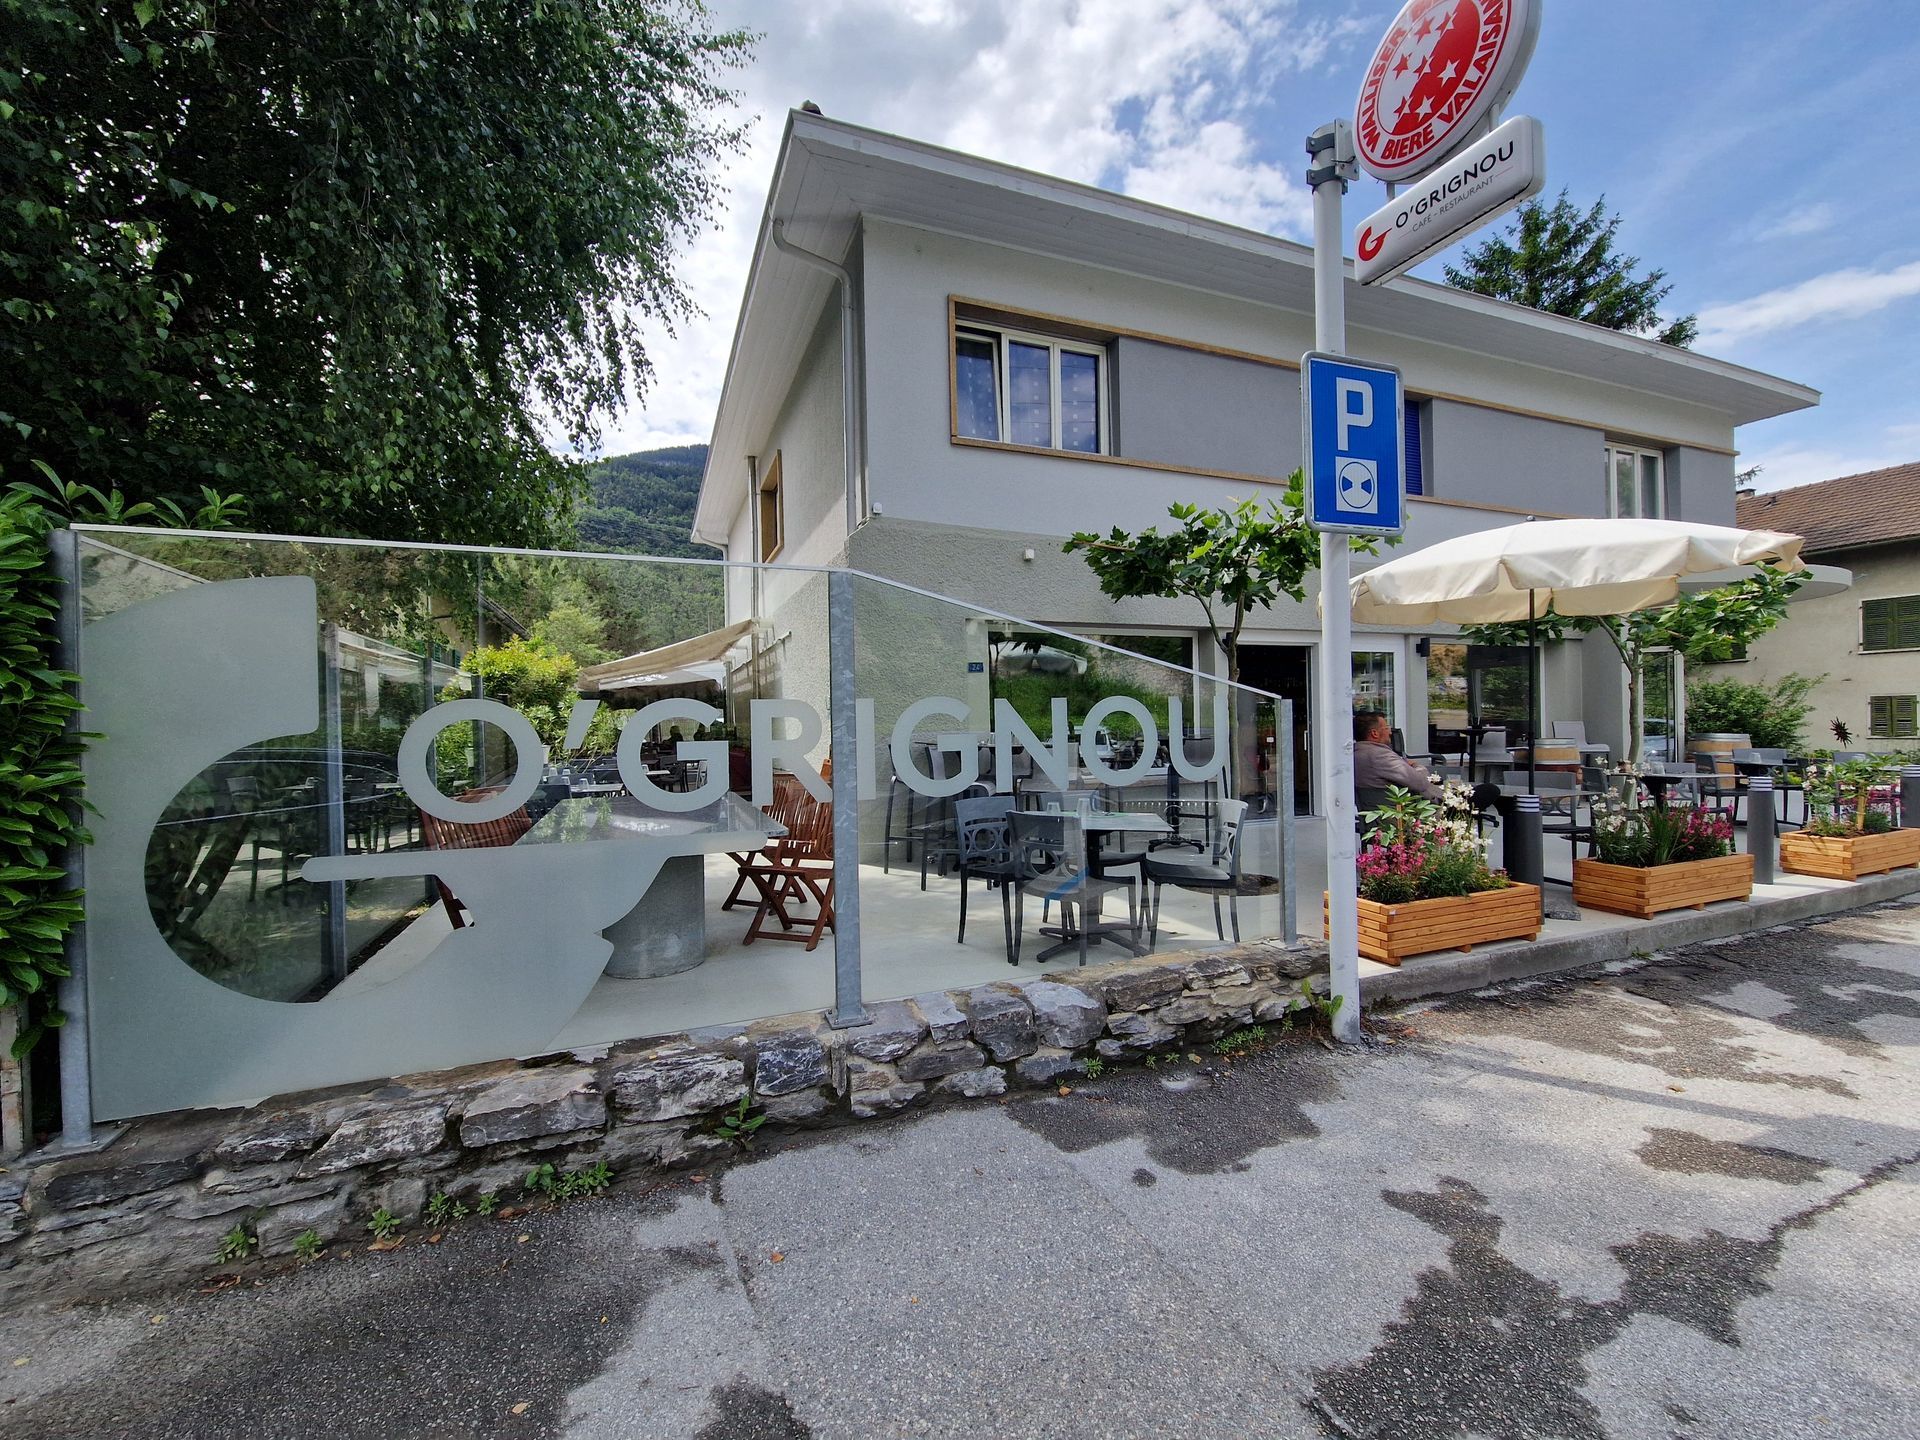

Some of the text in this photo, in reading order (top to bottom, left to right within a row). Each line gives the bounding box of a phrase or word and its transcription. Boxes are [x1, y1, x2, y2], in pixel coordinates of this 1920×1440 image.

[1361, 27, 1407, 153] WALLISER
[1381, 122, 1435, 160] BIERE
[1395, 141, 1514, 228] O'GRIGNOU
[1439, 175, 1494, 216] RESTAURANT
[1336, 376, 1374, 451] P
